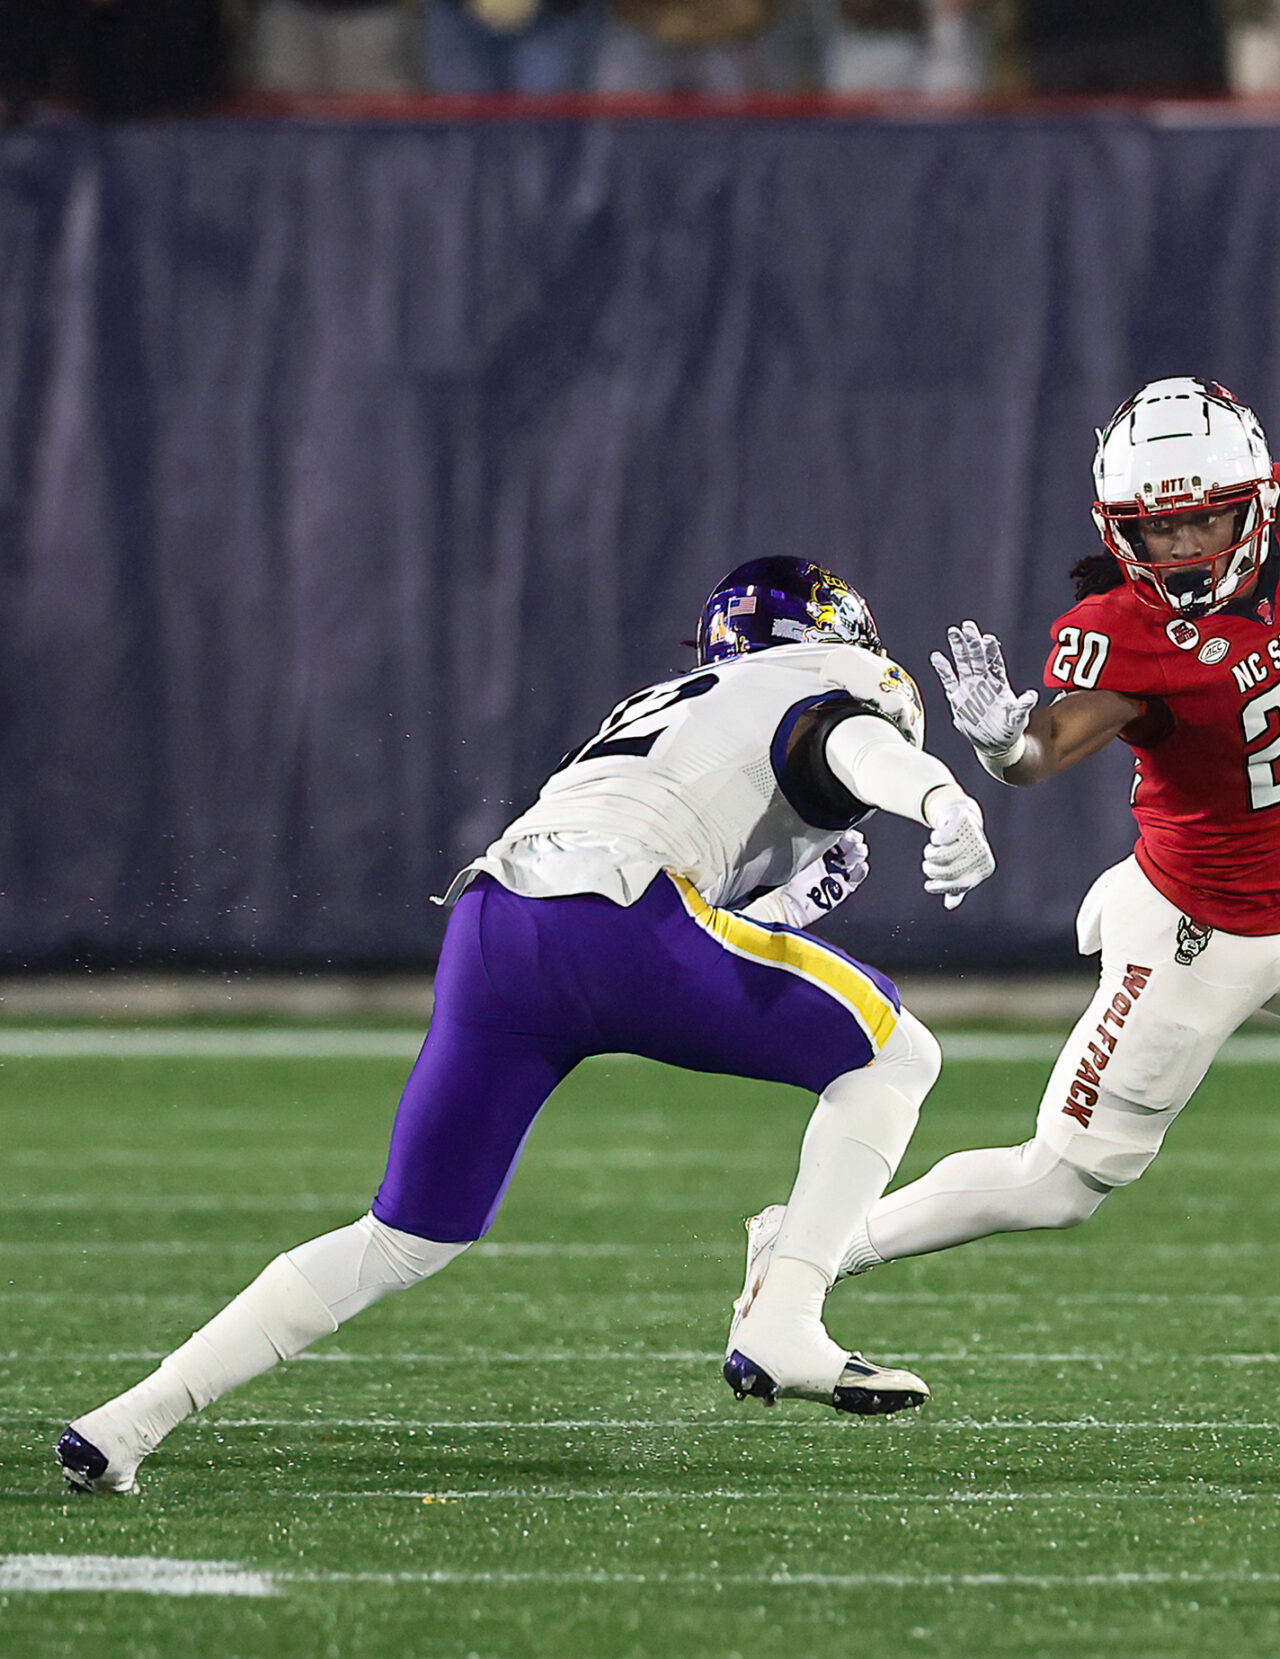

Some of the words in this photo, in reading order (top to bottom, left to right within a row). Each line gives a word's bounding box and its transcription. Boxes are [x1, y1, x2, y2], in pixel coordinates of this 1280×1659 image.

[1161, 477, 1185, 493] HTT
[1052, 626, 1110, 689] 20
[1232, 652, 1268, 694] NC
[1061, 963, 1153, 1129] WOLFPACK
